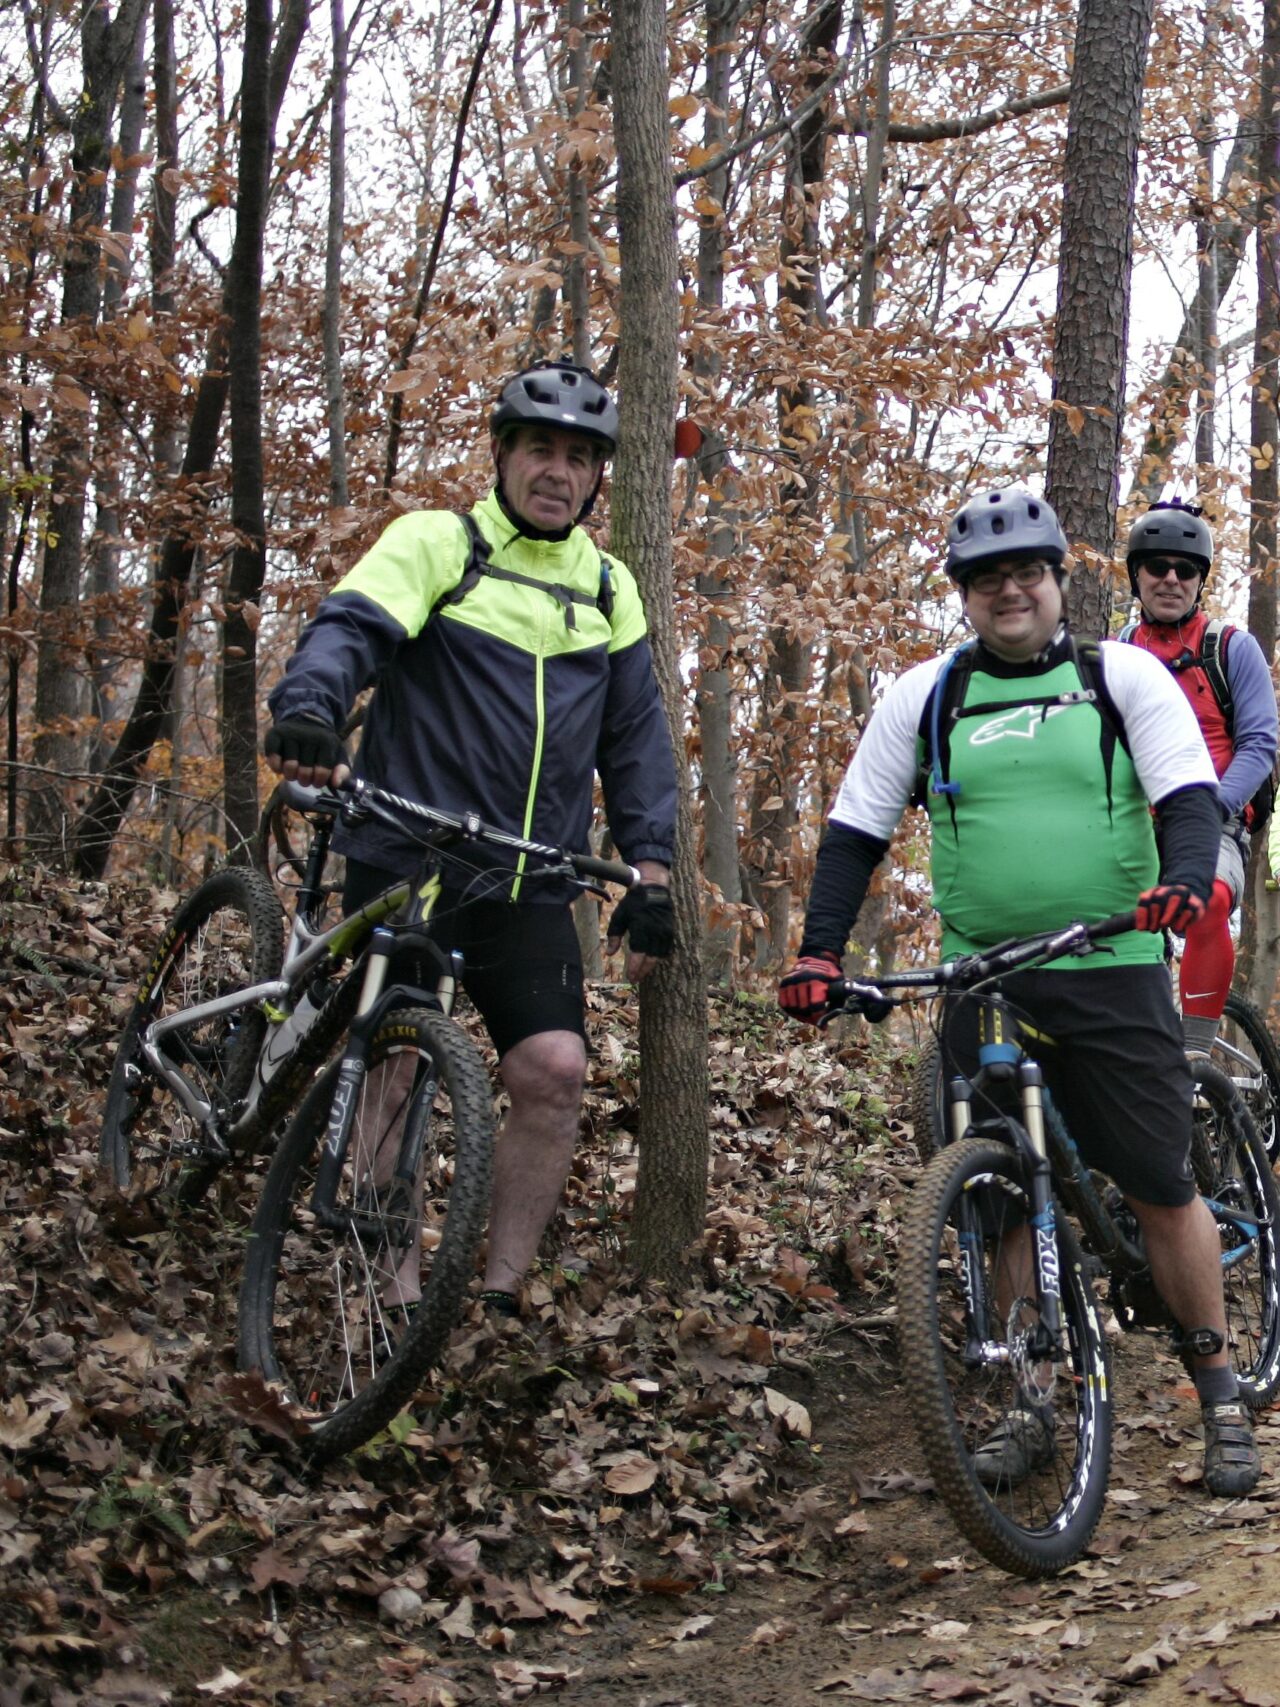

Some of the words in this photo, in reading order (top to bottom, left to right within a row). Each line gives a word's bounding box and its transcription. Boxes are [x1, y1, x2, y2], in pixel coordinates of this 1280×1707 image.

[138, 927, 176, 1003] MAXXIS
[324, 1076, 353, 1157] FOX
[1036, 1228, 1061, 1298] FOX
